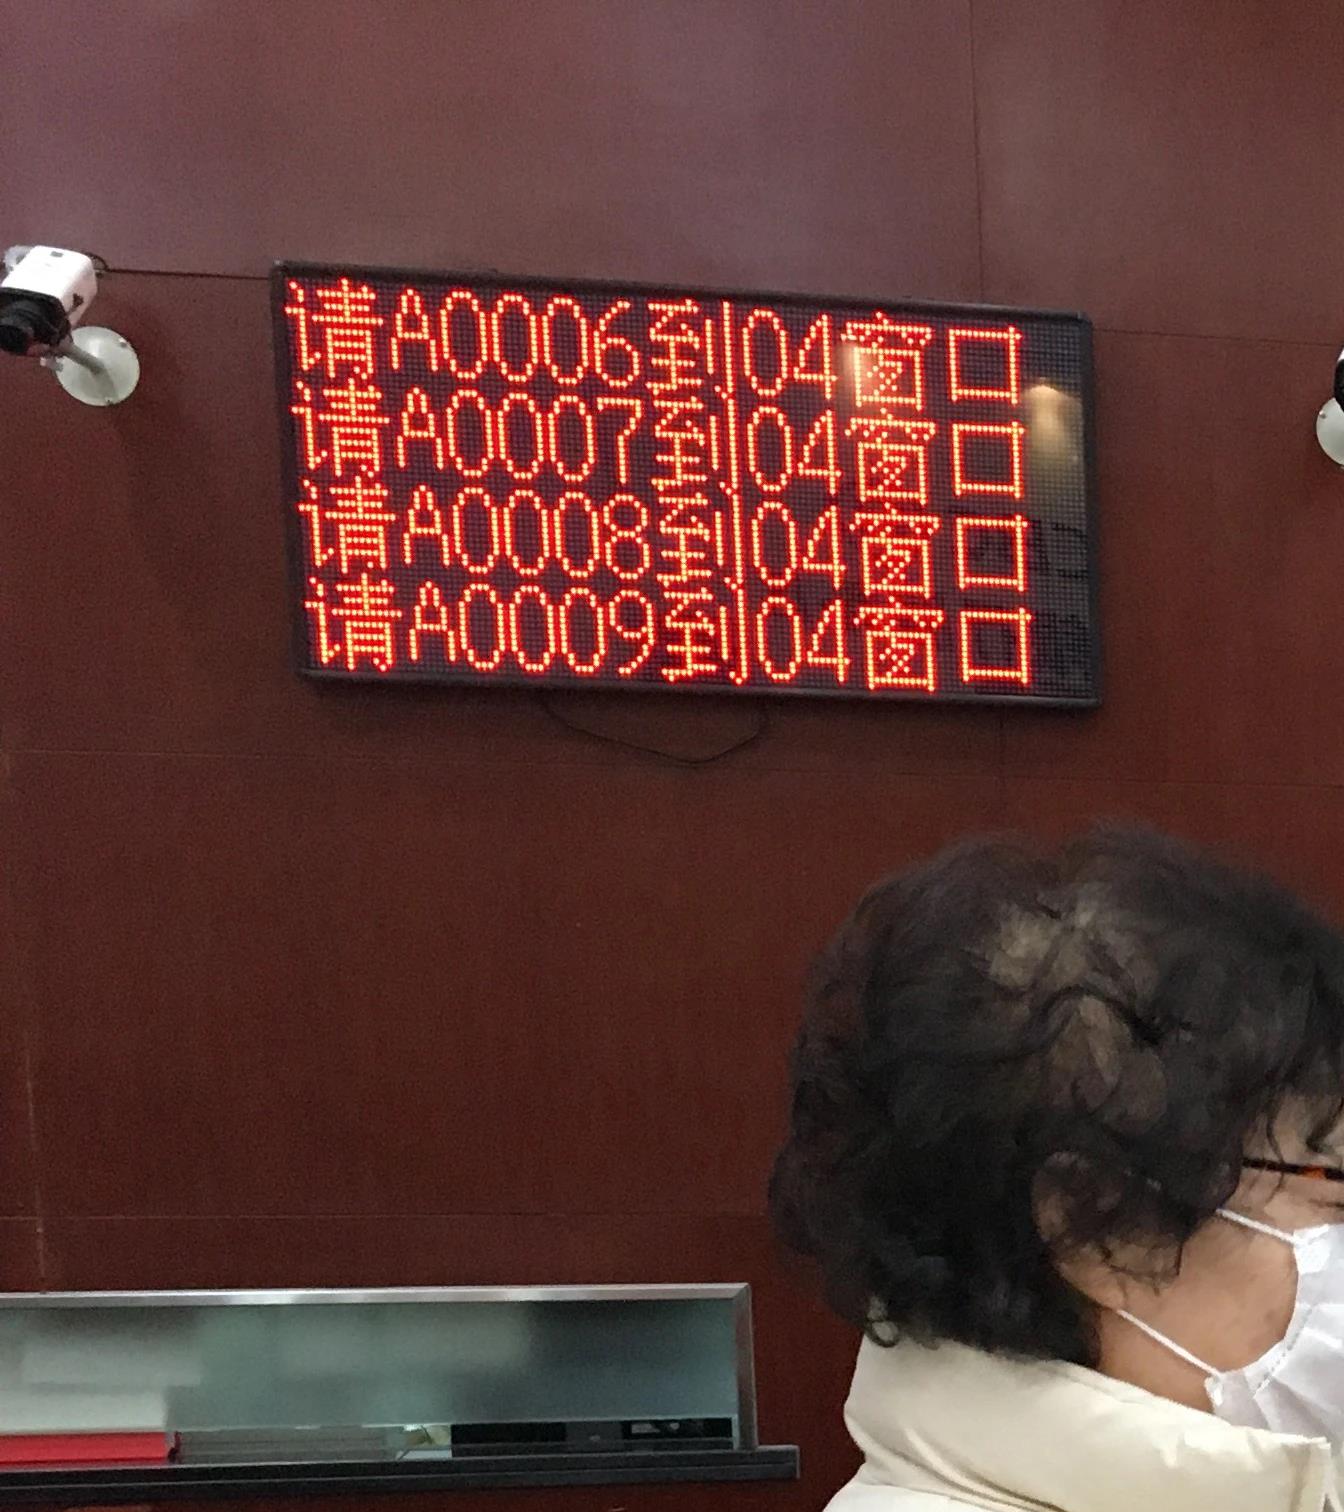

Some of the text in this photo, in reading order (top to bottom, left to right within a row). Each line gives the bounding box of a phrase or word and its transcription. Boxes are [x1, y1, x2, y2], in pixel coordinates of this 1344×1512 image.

[285, 278, 1023, 409] 请A0006到04窗口
[291, 377, 1026, 505] 请A0007到04窗口
[298, 476, 1030, 599] 请A0008到04窗口
[305, 574, 1033, 692] 请A0009到04窗口
